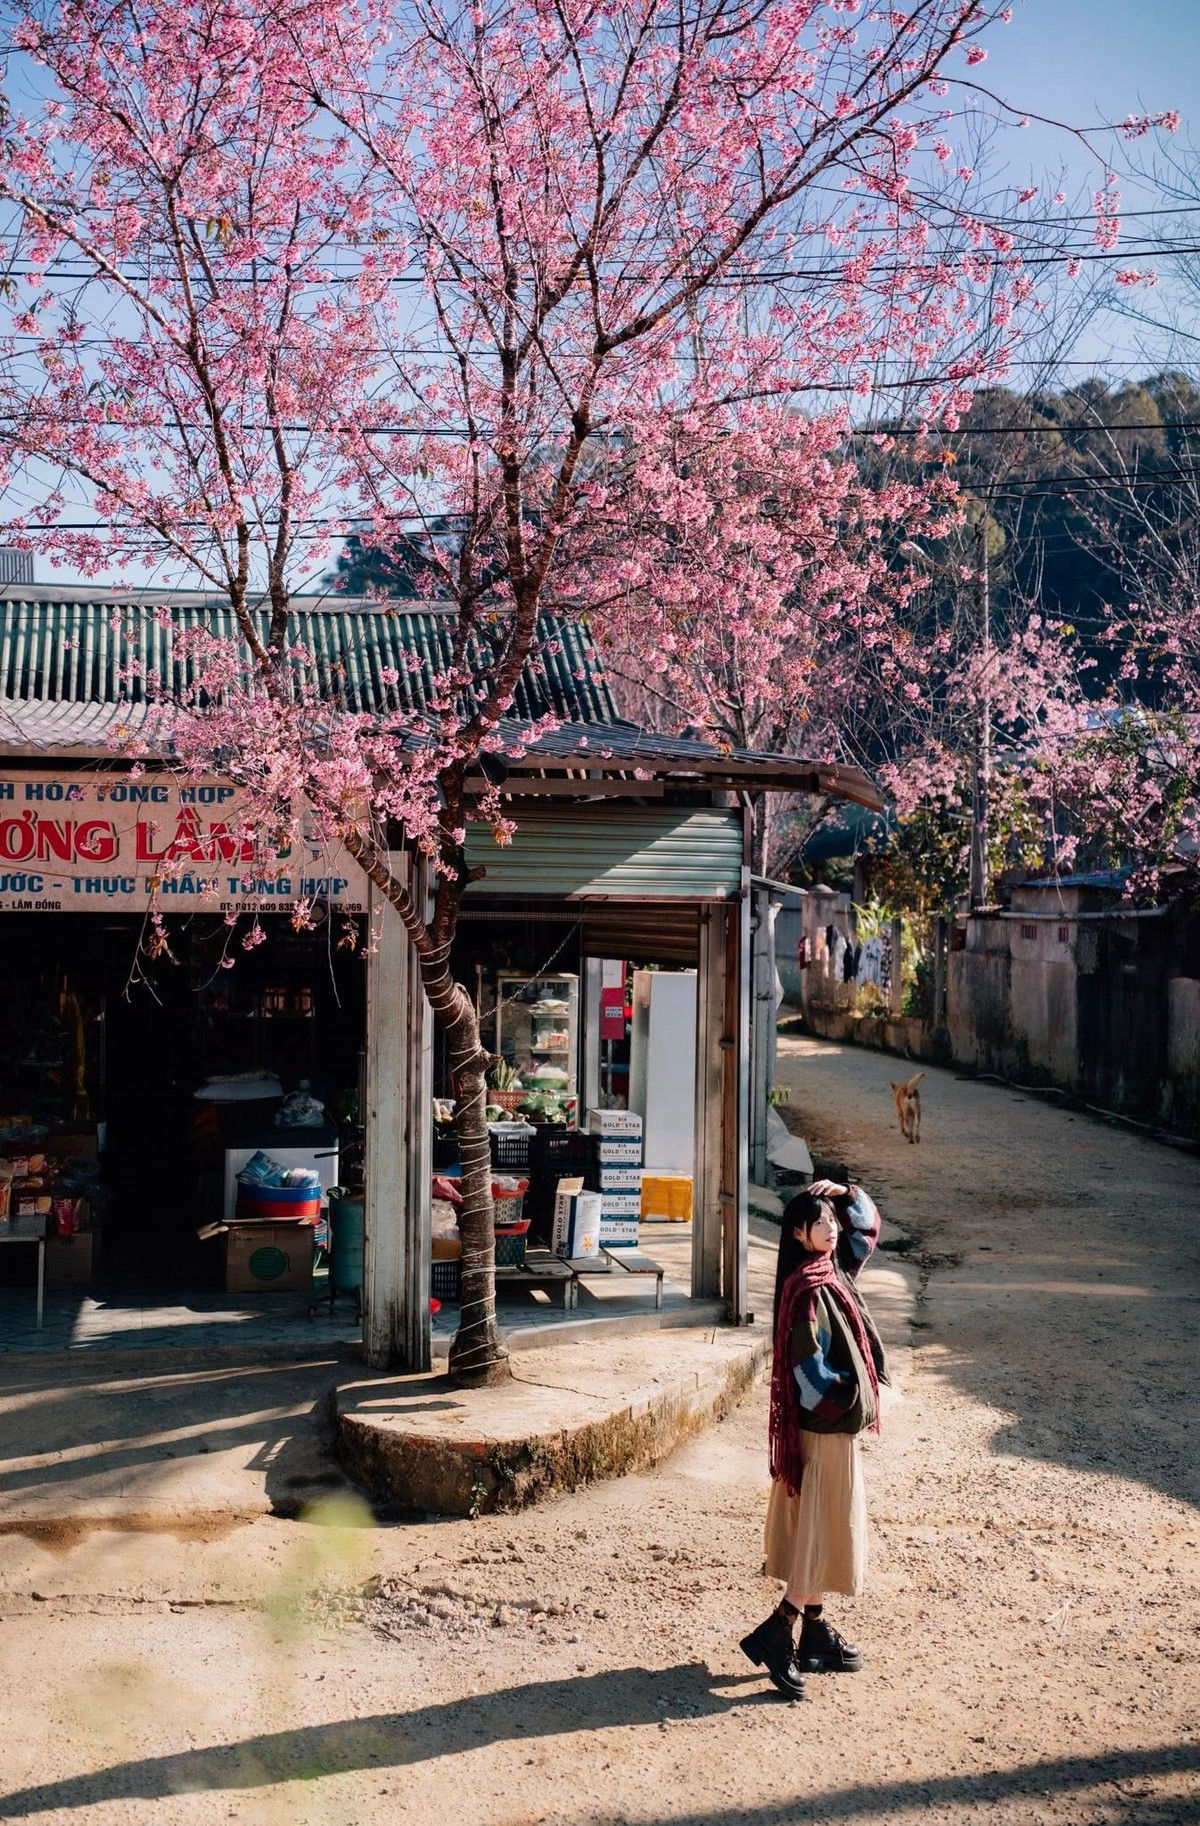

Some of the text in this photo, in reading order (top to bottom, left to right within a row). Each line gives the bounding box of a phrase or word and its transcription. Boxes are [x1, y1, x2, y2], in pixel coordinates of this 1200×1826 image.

[25, 780, 84, 801] HÓA
[135, 808, 256, 863] LÂM
[71, 874, 136, 897] THỰC
[300, 876, 349, 898] HỢP
[12, 898, 33, 910] LÂM
[260, 902, 276, 911] 609
